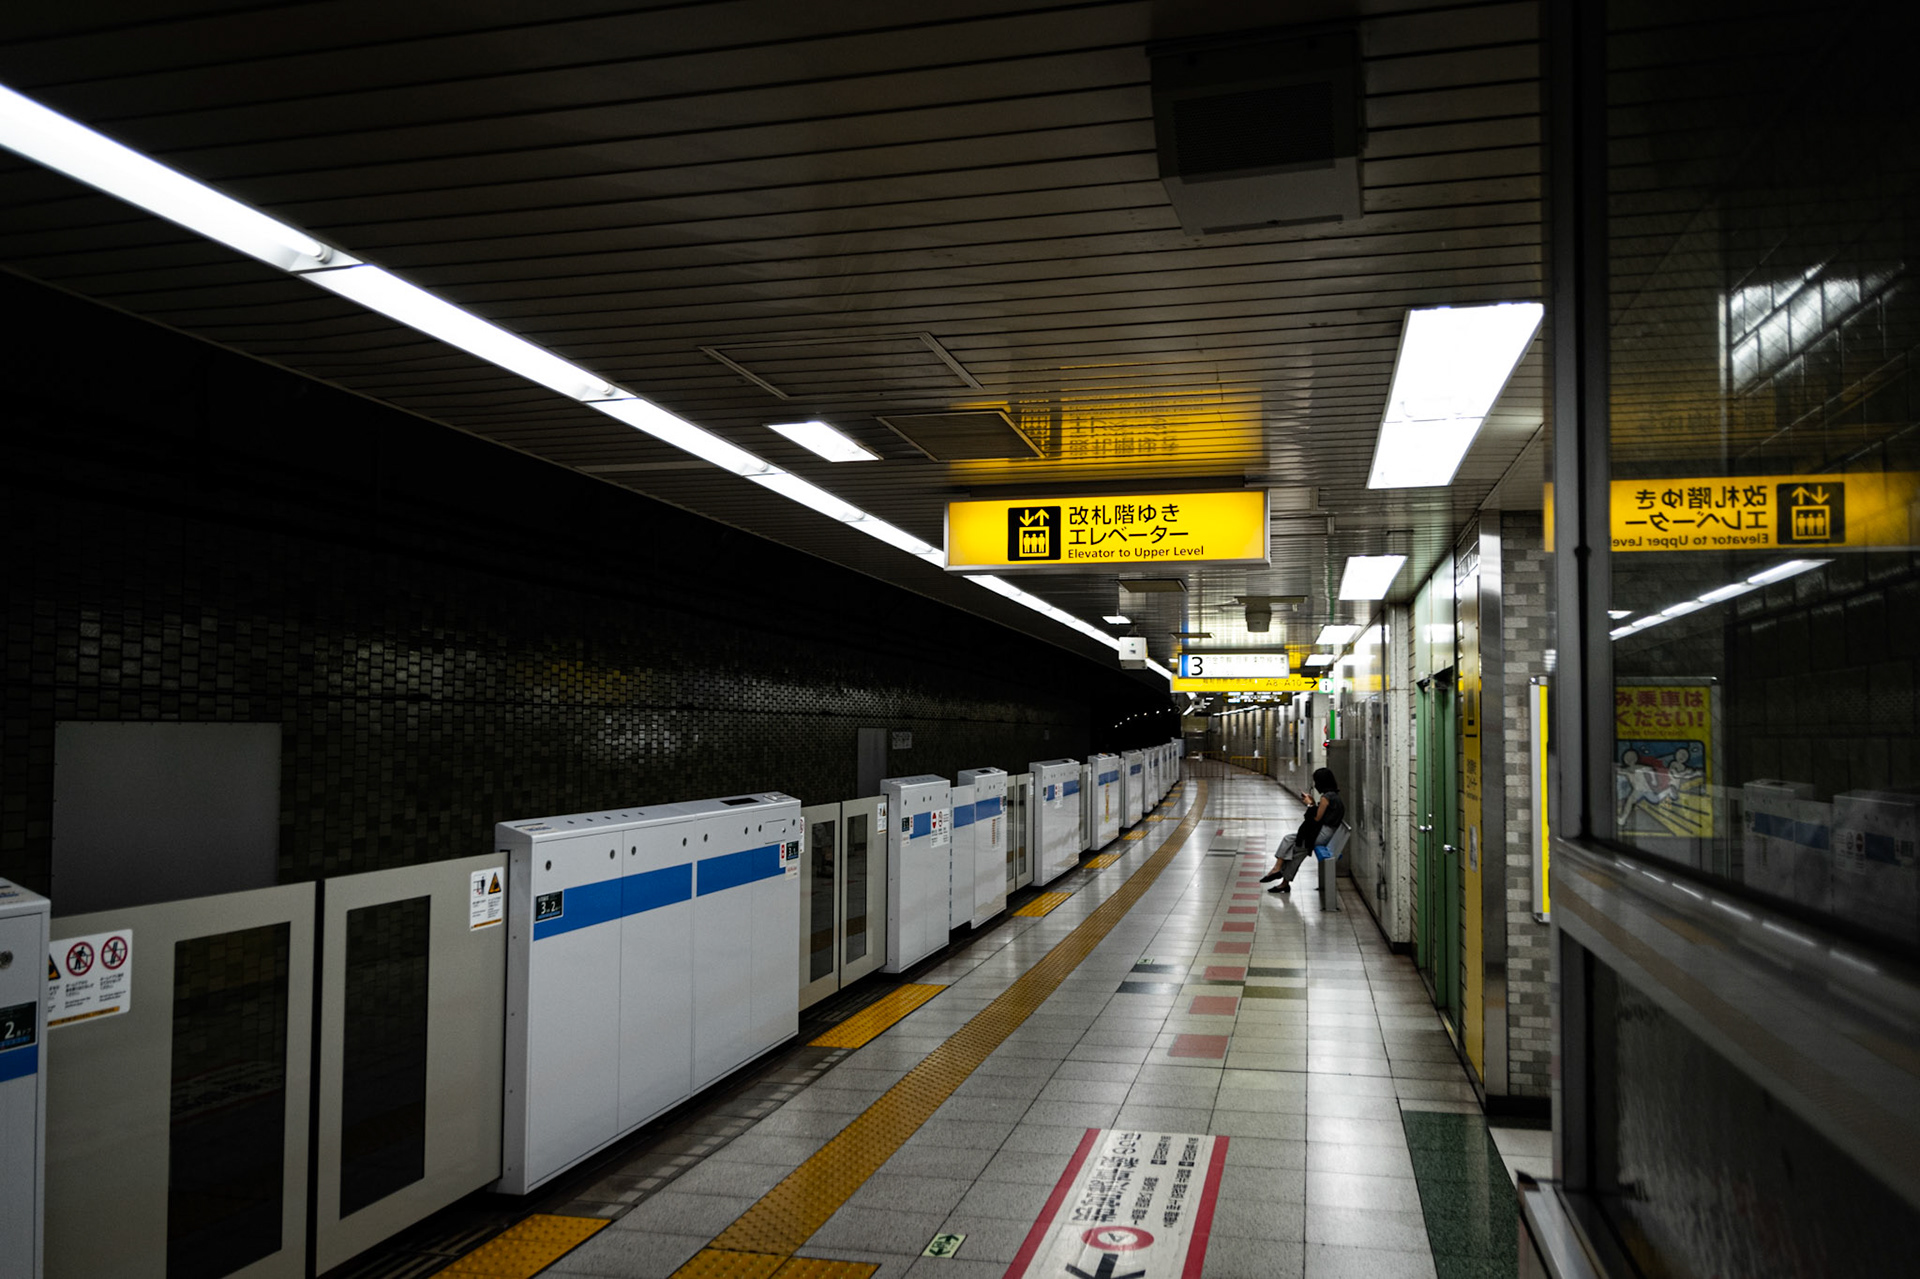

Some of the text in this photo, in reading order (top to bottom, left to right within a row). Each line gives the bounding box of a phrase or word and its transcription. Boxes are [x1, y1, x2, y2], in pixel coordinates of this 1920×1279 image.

[1068, 503, 1180, 526] 改札階ゆき
[1068, 525, 1189, 546] エレベーター
[1068, 546, 1204, 560] Elevator to Upper Level
[1191, 656, 1203, 676] 3
